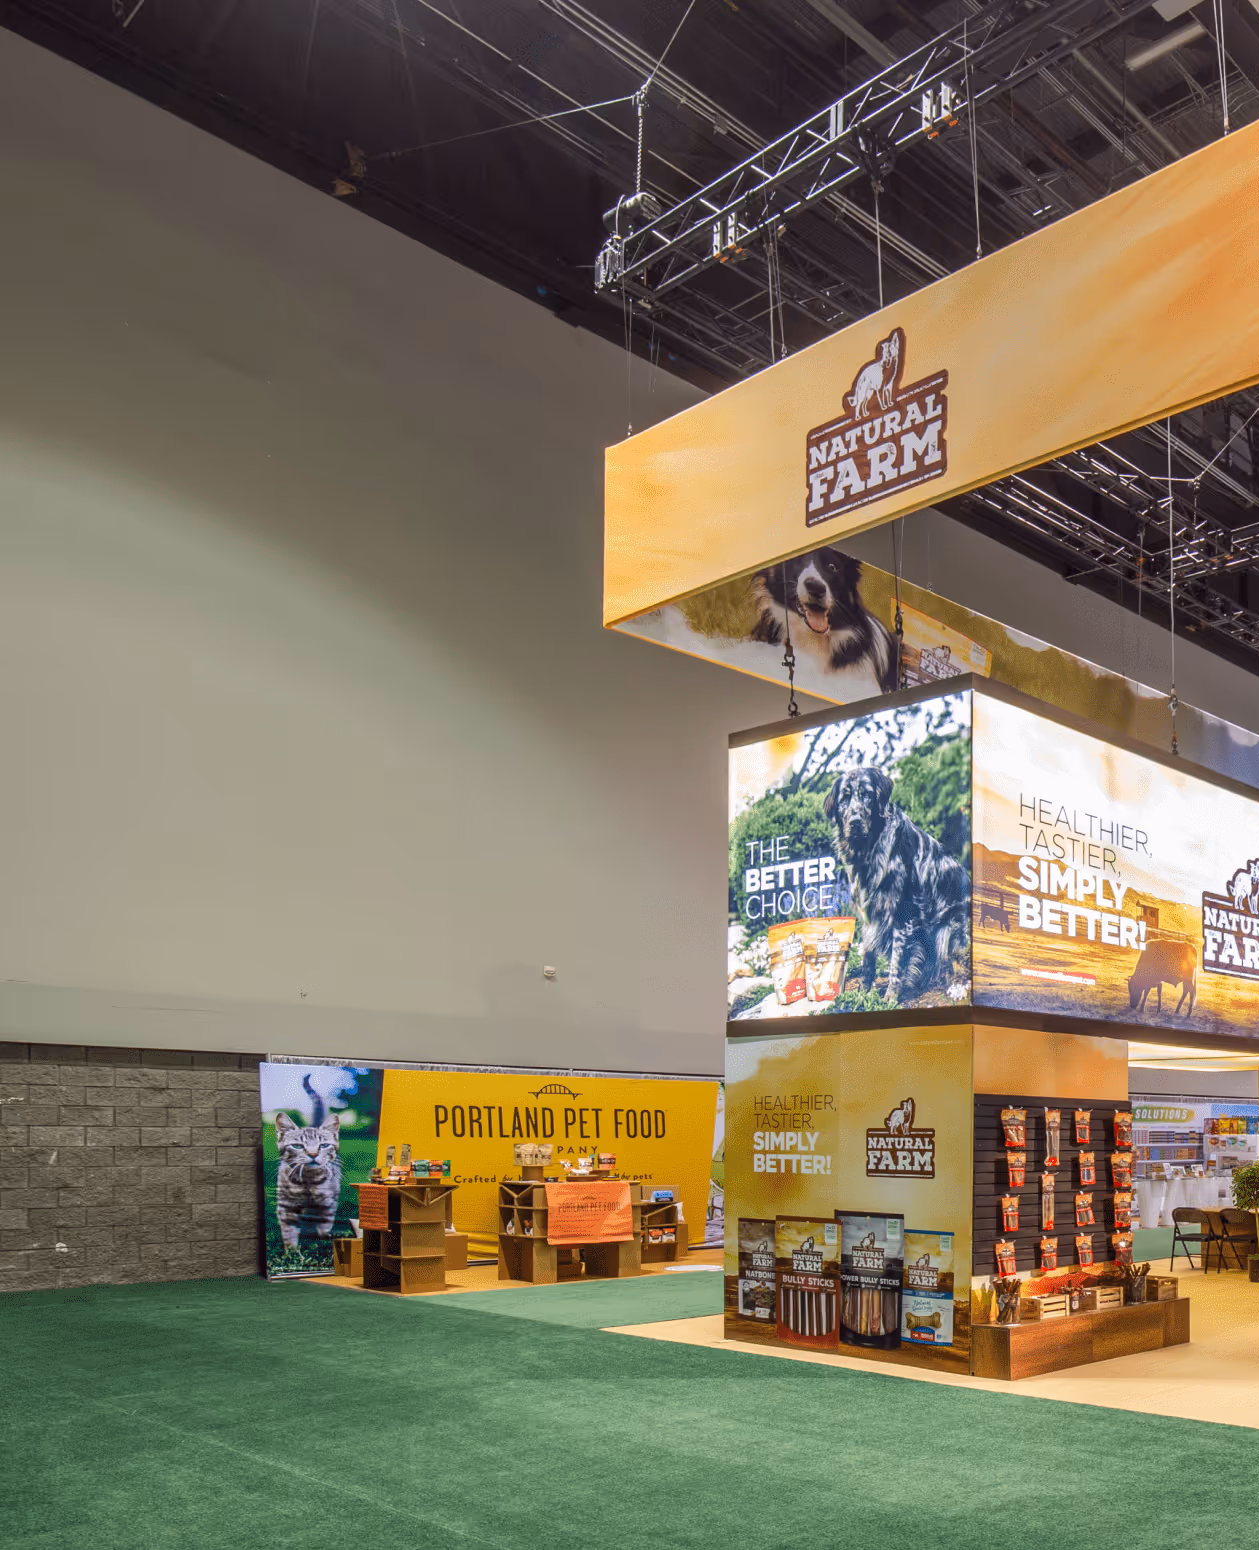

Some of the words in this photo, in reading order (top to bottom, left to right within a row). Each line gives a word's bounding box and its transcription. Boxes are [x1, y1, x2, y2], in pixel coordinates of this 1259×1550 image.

[809, 393, 943, 470] NATURAL
[808, 419, 942, 512] FARM
[1019, 792, 1153, 859] HEALTHIER,
[745, 835, 791, 866] THE
[1019, 823, 1121, 877] TASTIER,
[744, 856, 836, 893] BETTER
[1017, 855, 1132, 910] SIMPLY
[745, 884, 834, 919] CHOICE
[1018, 893, 1148, 951] BETTER!
[754, 1094, 837, 1112] HEALTHIER,
[434, 1104, 555, 1138] PORTLAND
[564, 1107, 602, 1138] PET
[614, 1108, 666, 1139] FOOD
[1135, 1108, 1188, 1120] SOLUTIONS
[557, 1145, 599, 1154] PANY
[753, 1131, 820, 1151] SIMPLY
[867, 1137, 933, 1150] NATURAL
[753, 1154, 833, 1175] BETTER!
[867, 1151, 934, 1171] FARM
[453, 1175, 497, 1184] Crafted
[752, 1259, 774, 1267] FARM
[793, 1253, 823, 1262] NATURAL
[852, 1250, 884, 1259] NATURAL
[852, 1257, 884, 1270] FARM
[792, 1260, 823, 1273] FARM
[908, 1268, 938, 1278] NATURAL
[782, 1274, 806, 1285] BULLY
[808, 1276, 834, 1288] STICKS
[860, 1275, 878, 1284] BULLY
[880, 1278, 900, 1287] STICKS
[908, 1275, 938, 1287] FARM
